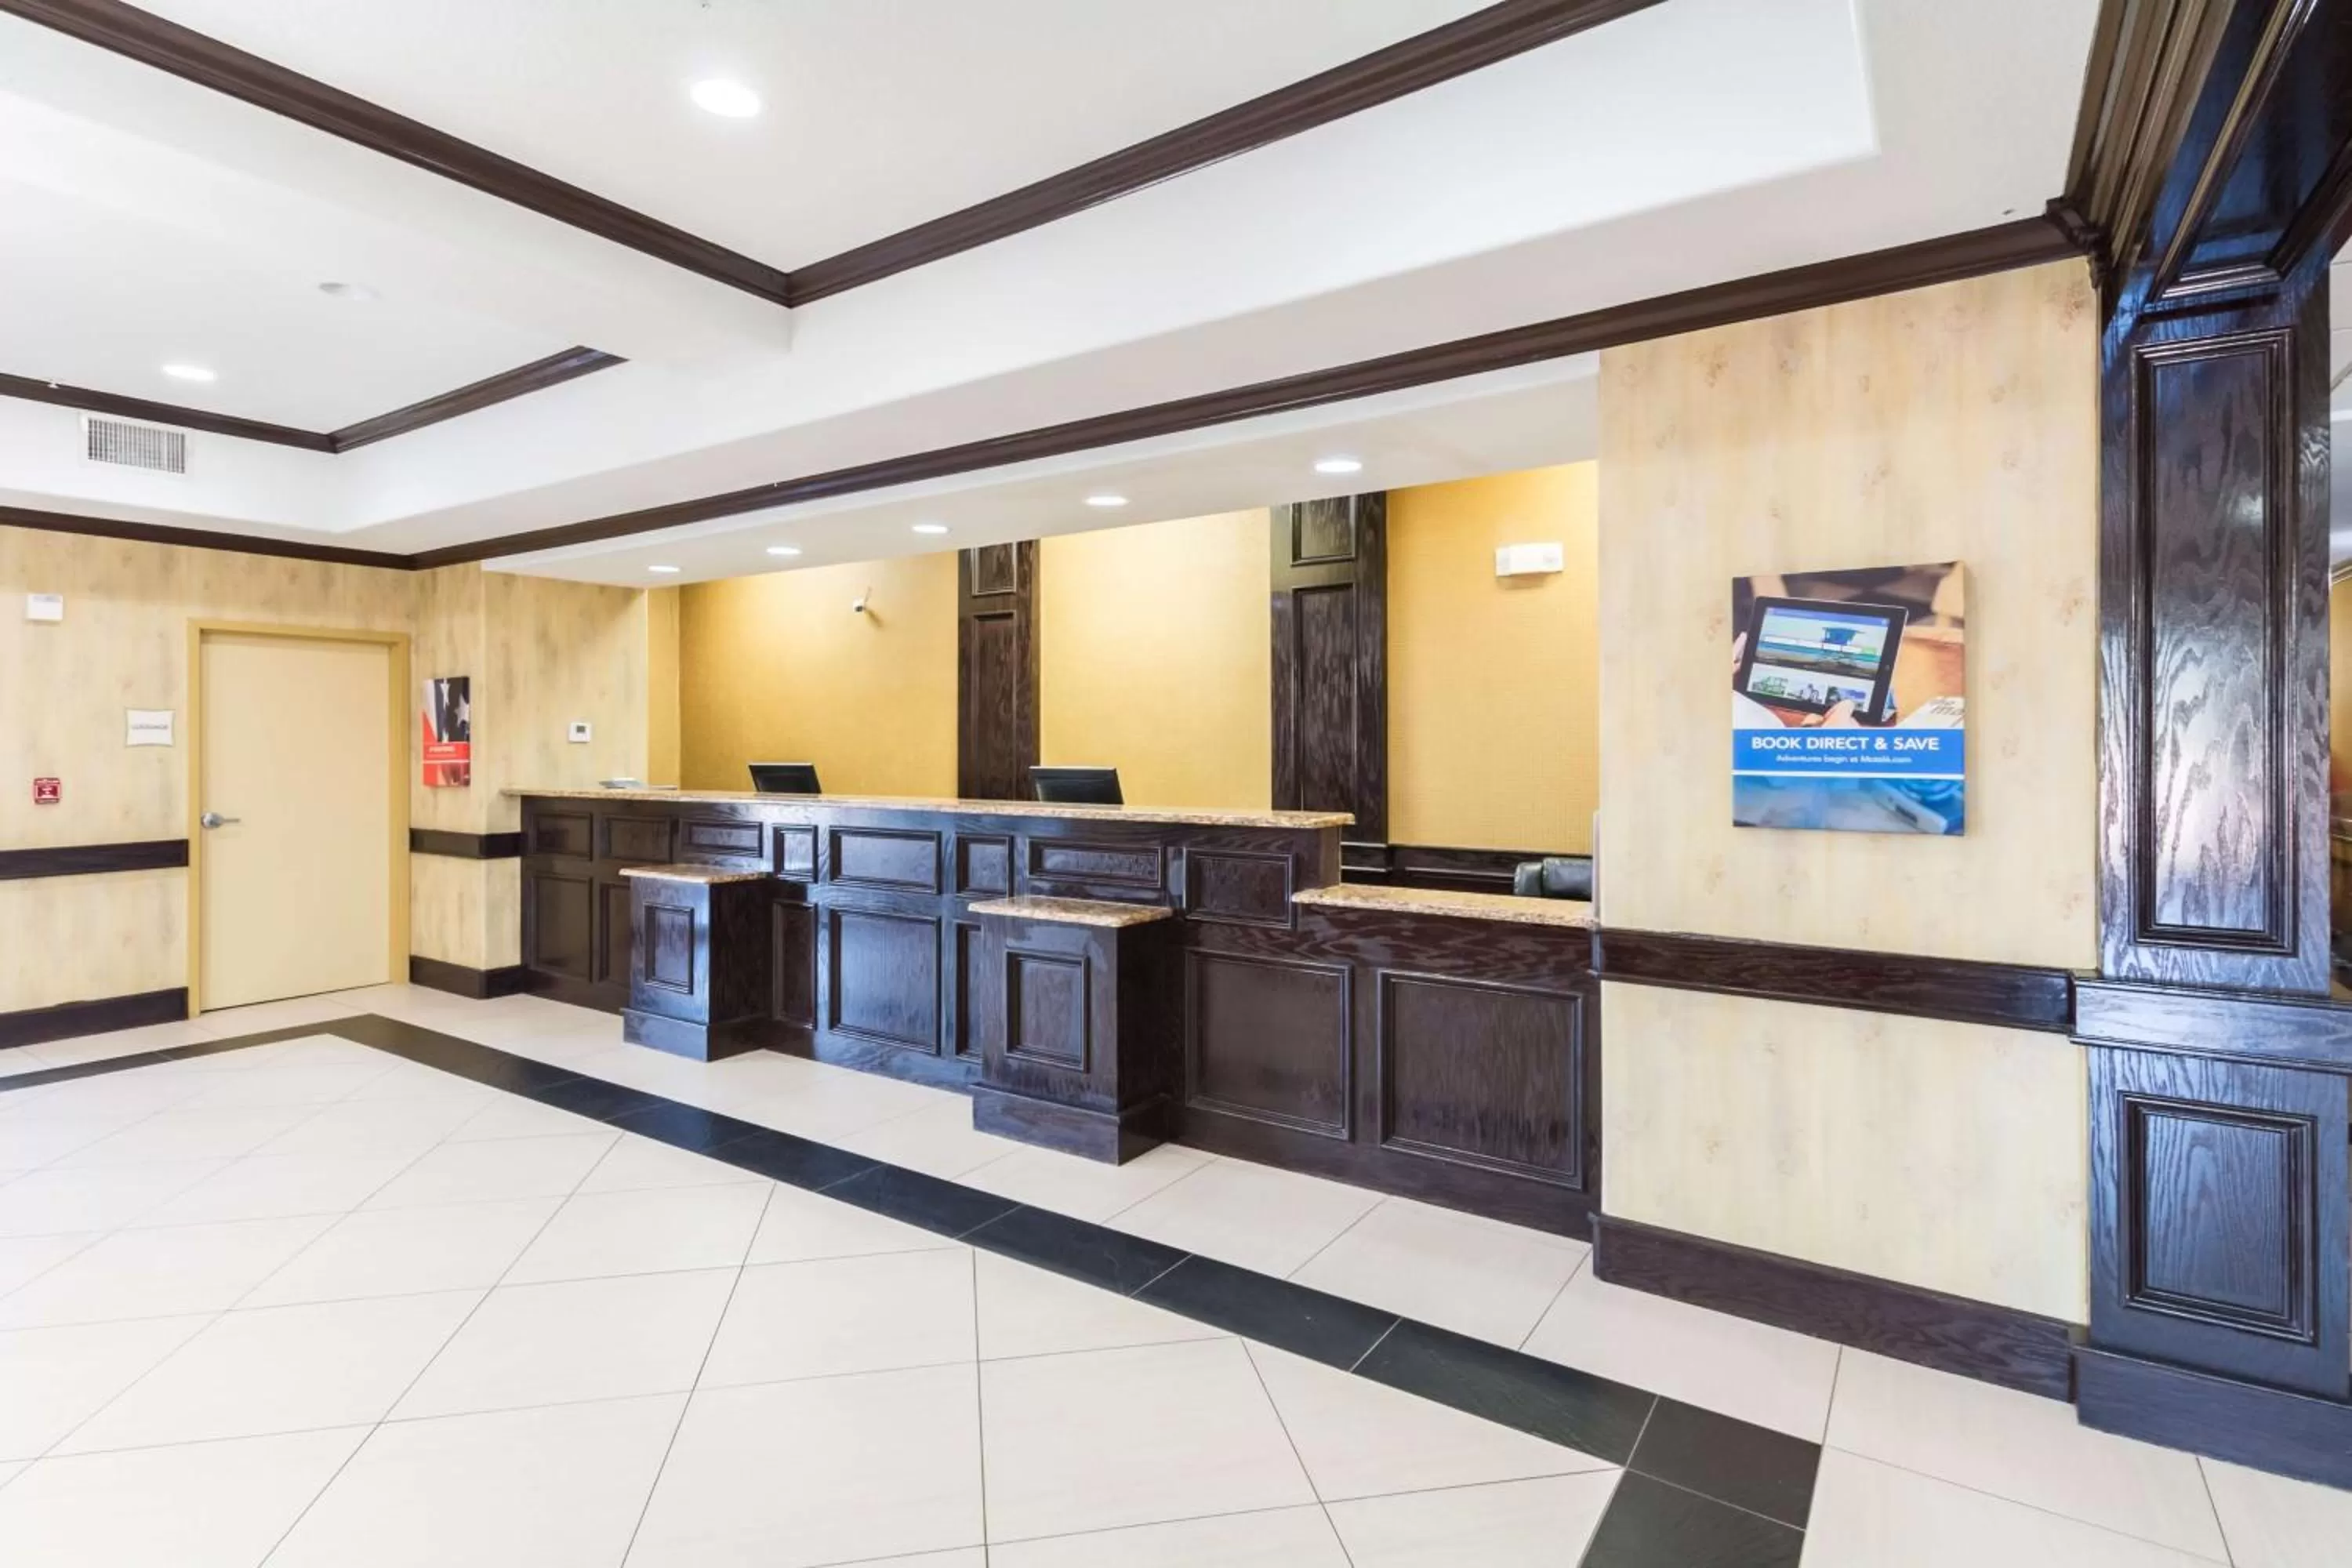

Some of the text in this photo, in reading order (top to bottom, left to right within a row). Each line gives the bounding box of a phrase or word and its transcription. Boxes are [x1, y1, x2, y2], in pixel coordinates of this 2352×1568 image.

[1751, 737, 1940, 750] BOOK DIRECT & SAVE
